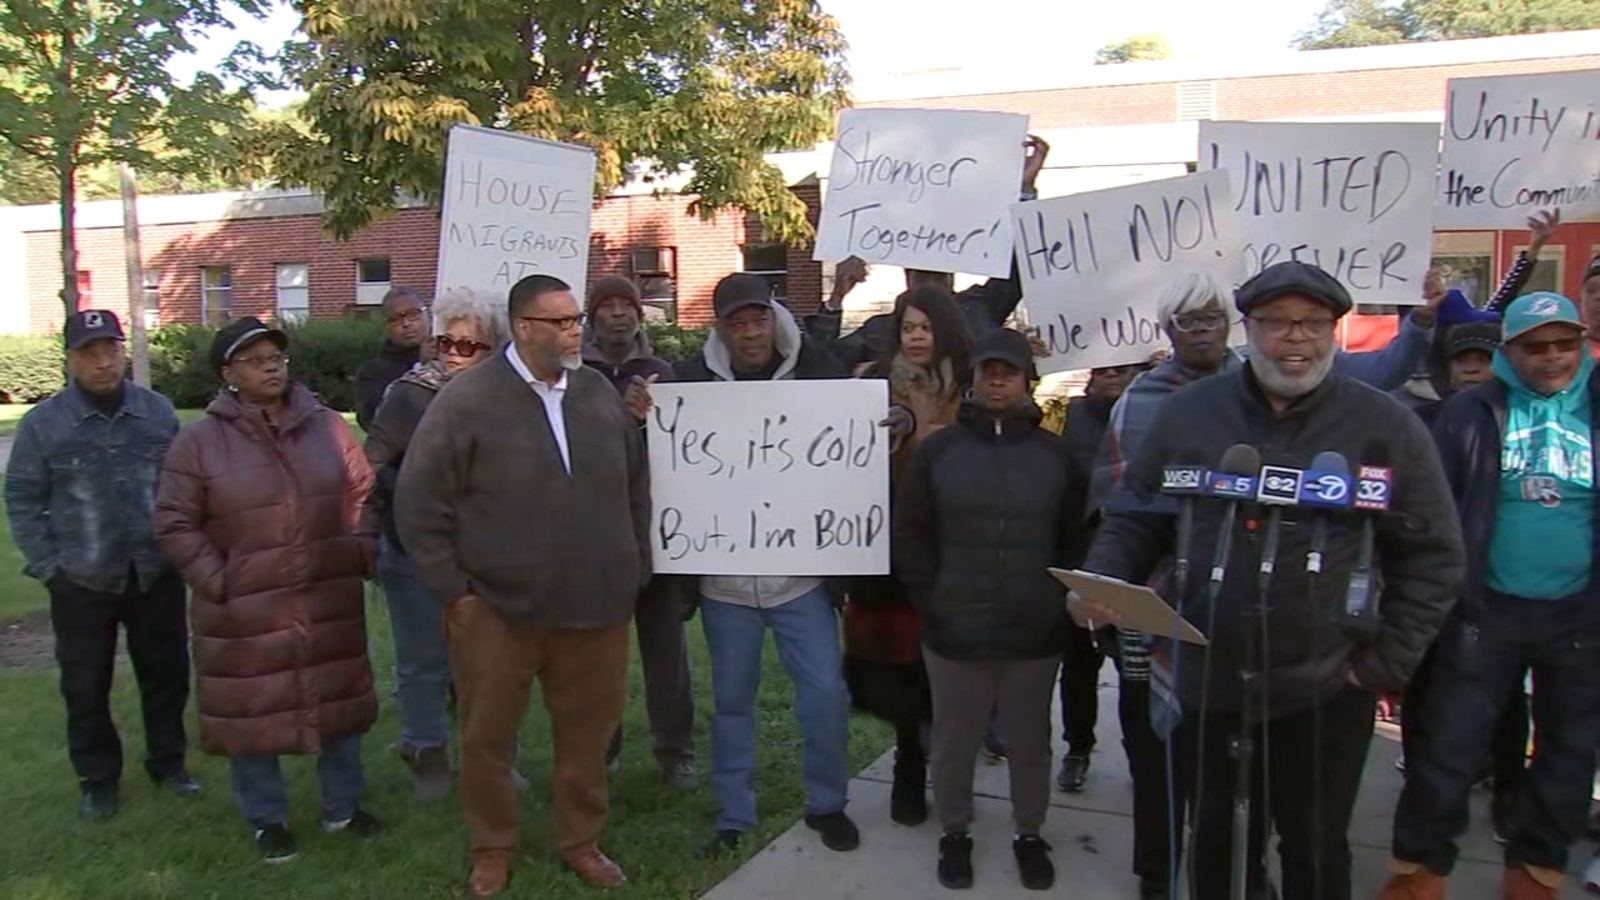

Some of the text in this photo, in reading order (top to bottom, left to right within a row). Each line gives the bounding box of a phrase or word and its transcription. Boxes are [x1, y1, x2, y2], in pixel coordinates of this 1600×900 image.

[1450, 89, 1567, 153] Unity
[833, 127, 977, 204] Stronger
[458, 160, 581, 215] HOUSE
[1444, 169, 1486, 208] the
[450, 222, 579, 259] MIGRANTS
[839, 203, 1001, 260] Together!
[1018, 184, 1224, 279] Hell NO!
[491, 261, 540, 286] AT
[1036, 313, 1089, 354] We
[654, 395, 735, 479] Yes,
[747, 414, 794, 472] it's
[1164, 469, 1200, 483] WGN
[1235, 477, 1252, 492] 5
[1357, 480, 1386, 501] 32
[1361, 467, 1387, 479] FOX
[659, 506, 736, 560] But,
[749, 501, 796, 549] I'm
